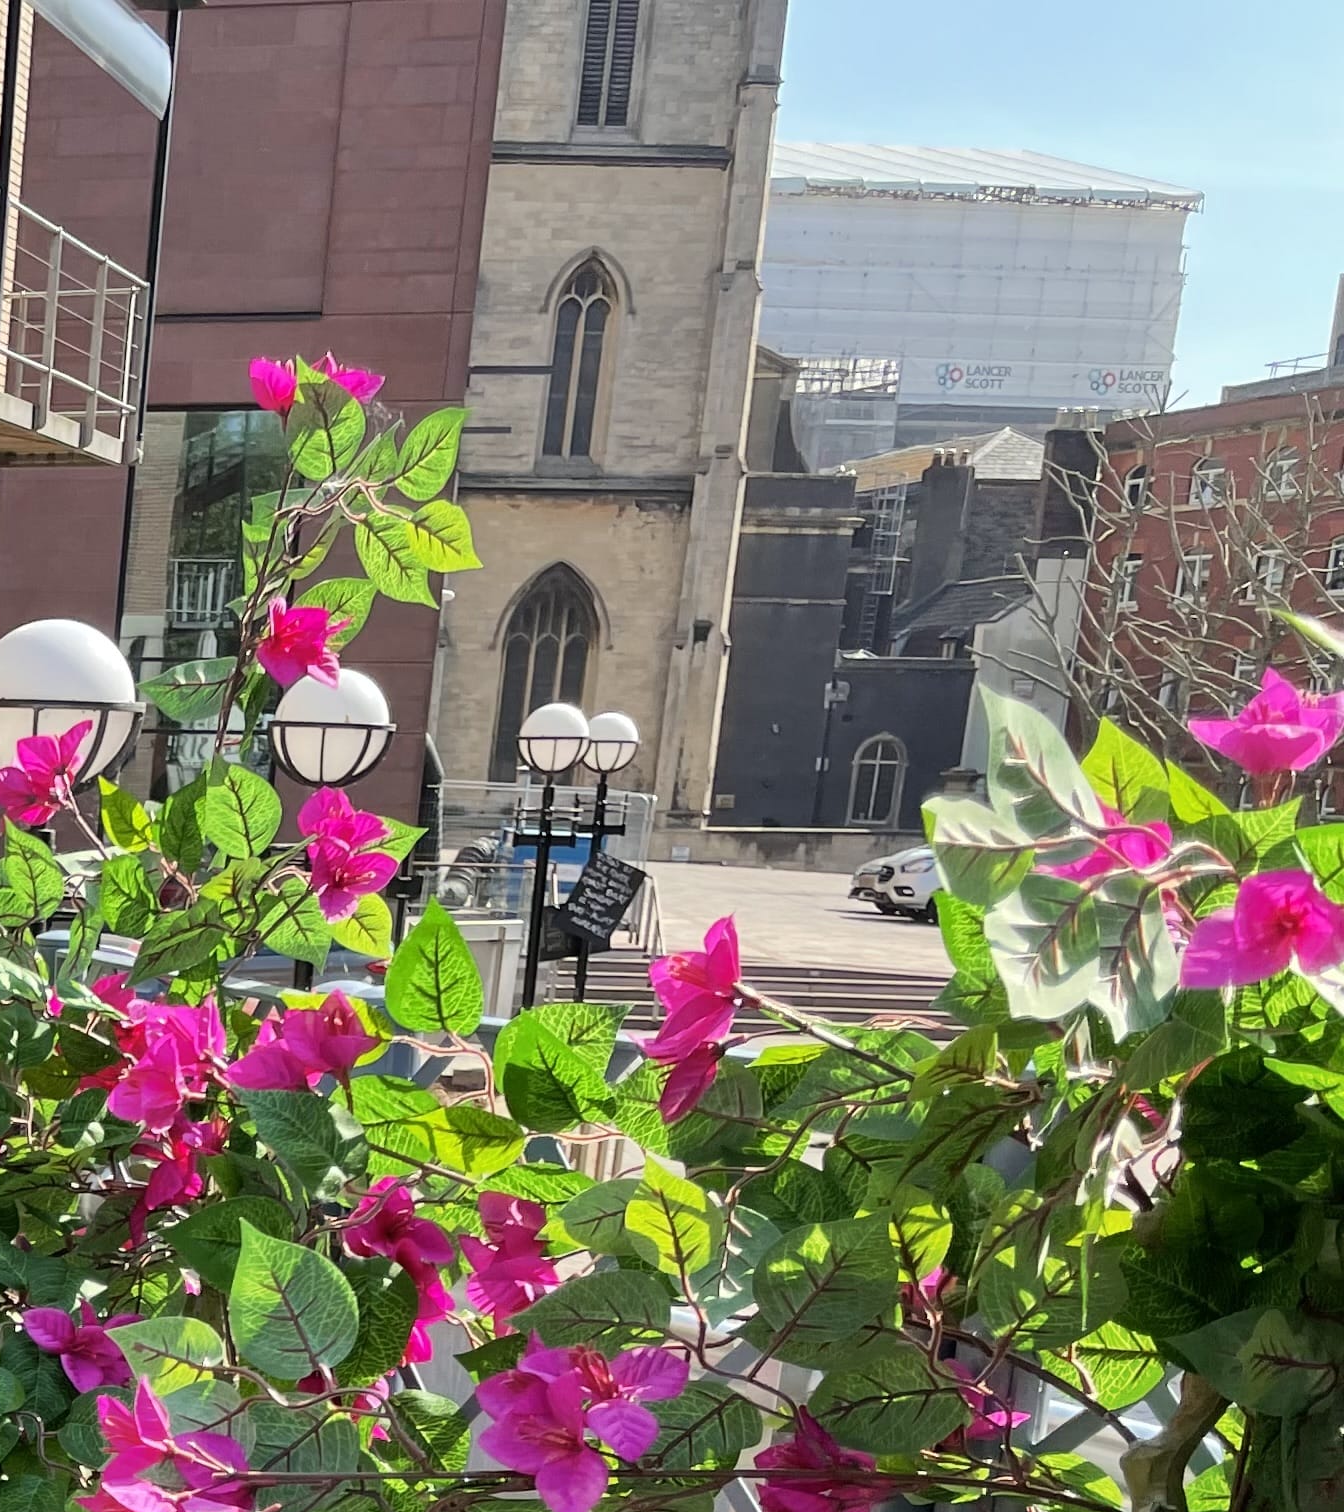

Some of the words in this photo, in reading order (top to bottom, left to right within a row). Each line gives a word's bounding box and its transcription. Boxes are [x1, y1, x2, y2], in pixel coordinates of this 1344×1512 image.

[966, 365, 1012, 376] LANCER
[1119, 369, 1164, 382] LANCER
[964, 377, 1004, 389] SCOTT
[1118, 383, 1158, 394] SCOTT
